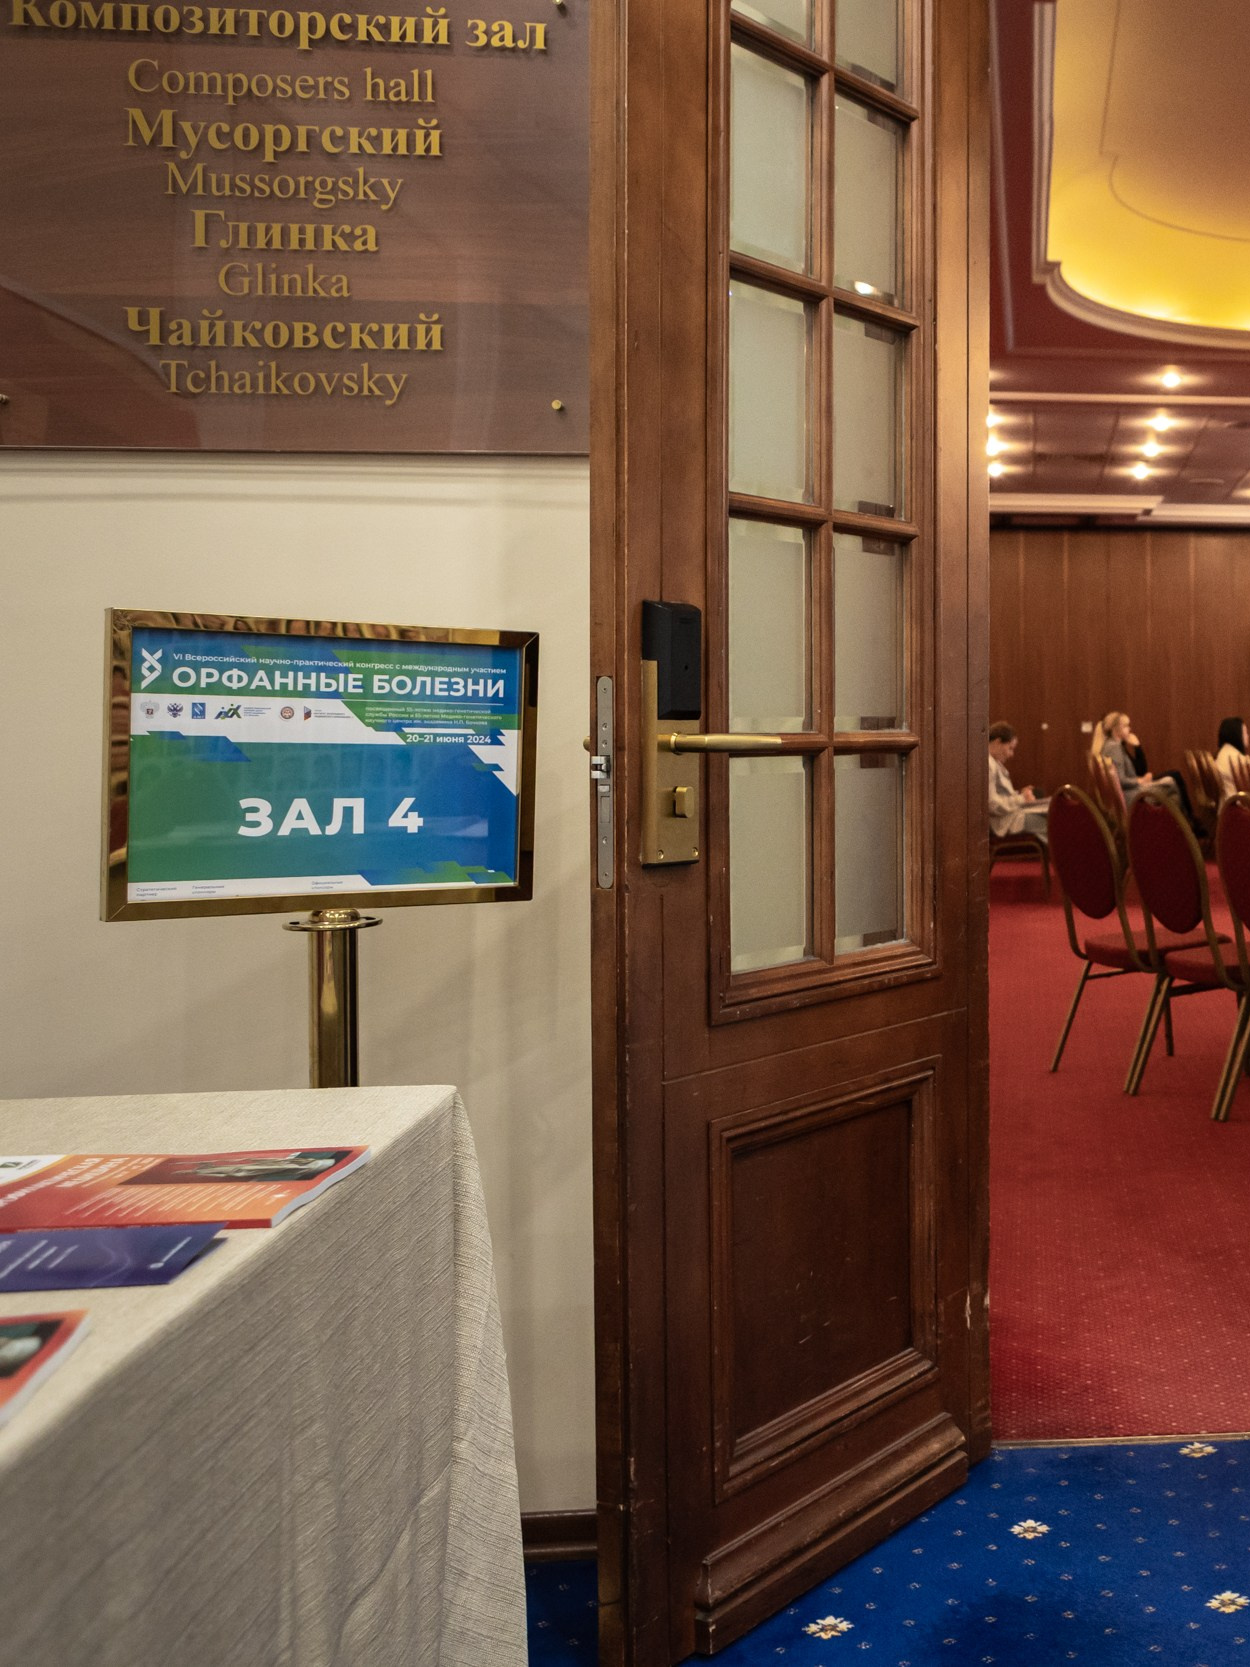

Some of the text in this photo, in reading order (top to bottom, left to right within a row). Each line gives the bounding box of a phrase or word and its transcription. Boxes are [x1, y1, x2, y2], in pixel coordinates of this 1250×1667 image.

[8, 0, 548, 50] Композиторский зал
[128, 59, 436, 104] Composers hall
[123, 108, 443, 162] Мусоргский
[165, 162, 403, 209] Mussorgsky
[191, 210, 379, 252] Глинка
[218, 262, 351, 296] Glinka
[123, 307, 444, 351] Чайковский
[160, 360, 408, 405] Tchaikovsky
[172, 666, 503, 697] ОРФАННЫЕ БОЛЕЗНИ
[173, 652, 182, 660] VI
[185, 653, 256, 663] Всероссийский
[259, 657, 353, 667] научно-практический
[402, 664, 468, 672] международным
[470, 664, 506, 674] участием
[467, 735, 490, 743] 2024
[237, 797, 423, 836] ЗАЛ 4
